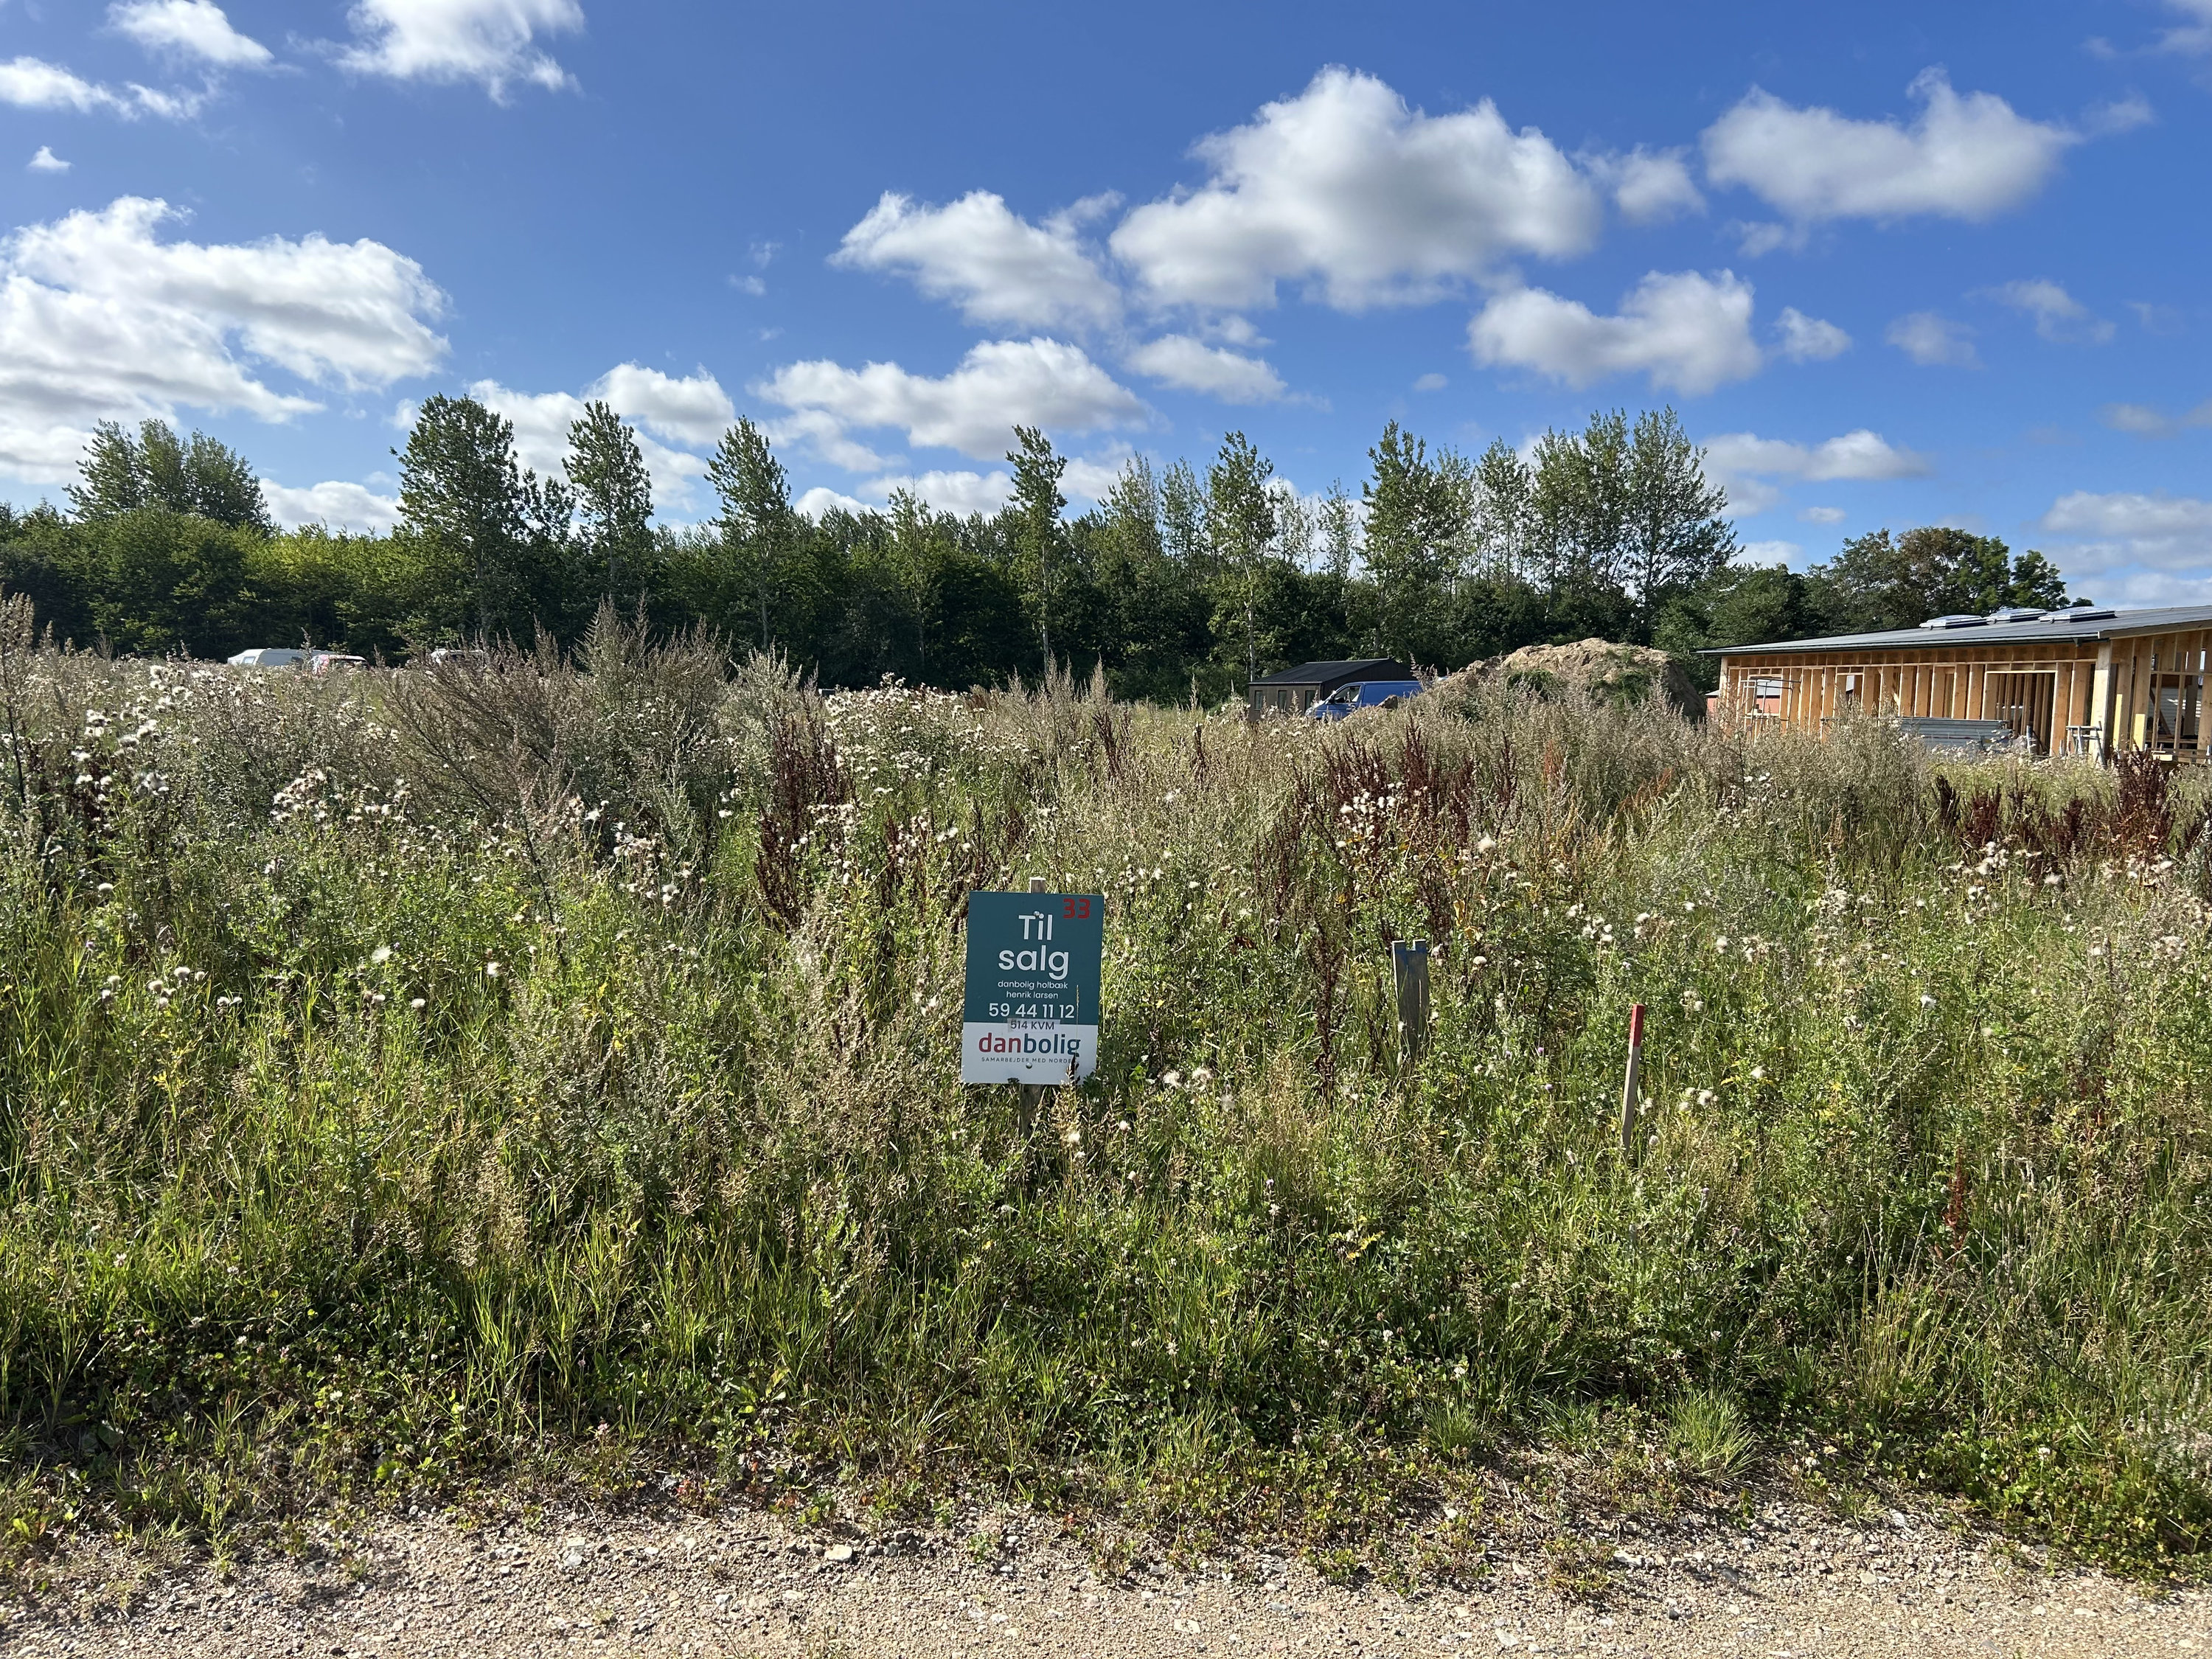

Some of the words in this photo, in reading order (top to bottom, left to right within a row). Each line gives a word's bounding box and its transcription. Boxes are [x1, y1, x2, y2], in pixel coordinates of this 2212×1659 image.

[1063, 898, 1091, 919] 33
[1019, 913, 1053, 940] Til
[998, 945, 1069, 980] salg
[998, 981, 1034, 990] danbolig
[1037, 981, 1068, 989] holbæk
[989, 1004, 1010, 1017] 59
[1015, 1004, 1037, 1018] 44
[1043, 1005, 1054, 1018] 11
[1060, 1005, 1074, 1018] 12
[1010, 1020, 1028, 1029] 514
[1031, 1022, 1054, 1030] KVM
[978, 1032, 1081, 1057] danbolig
